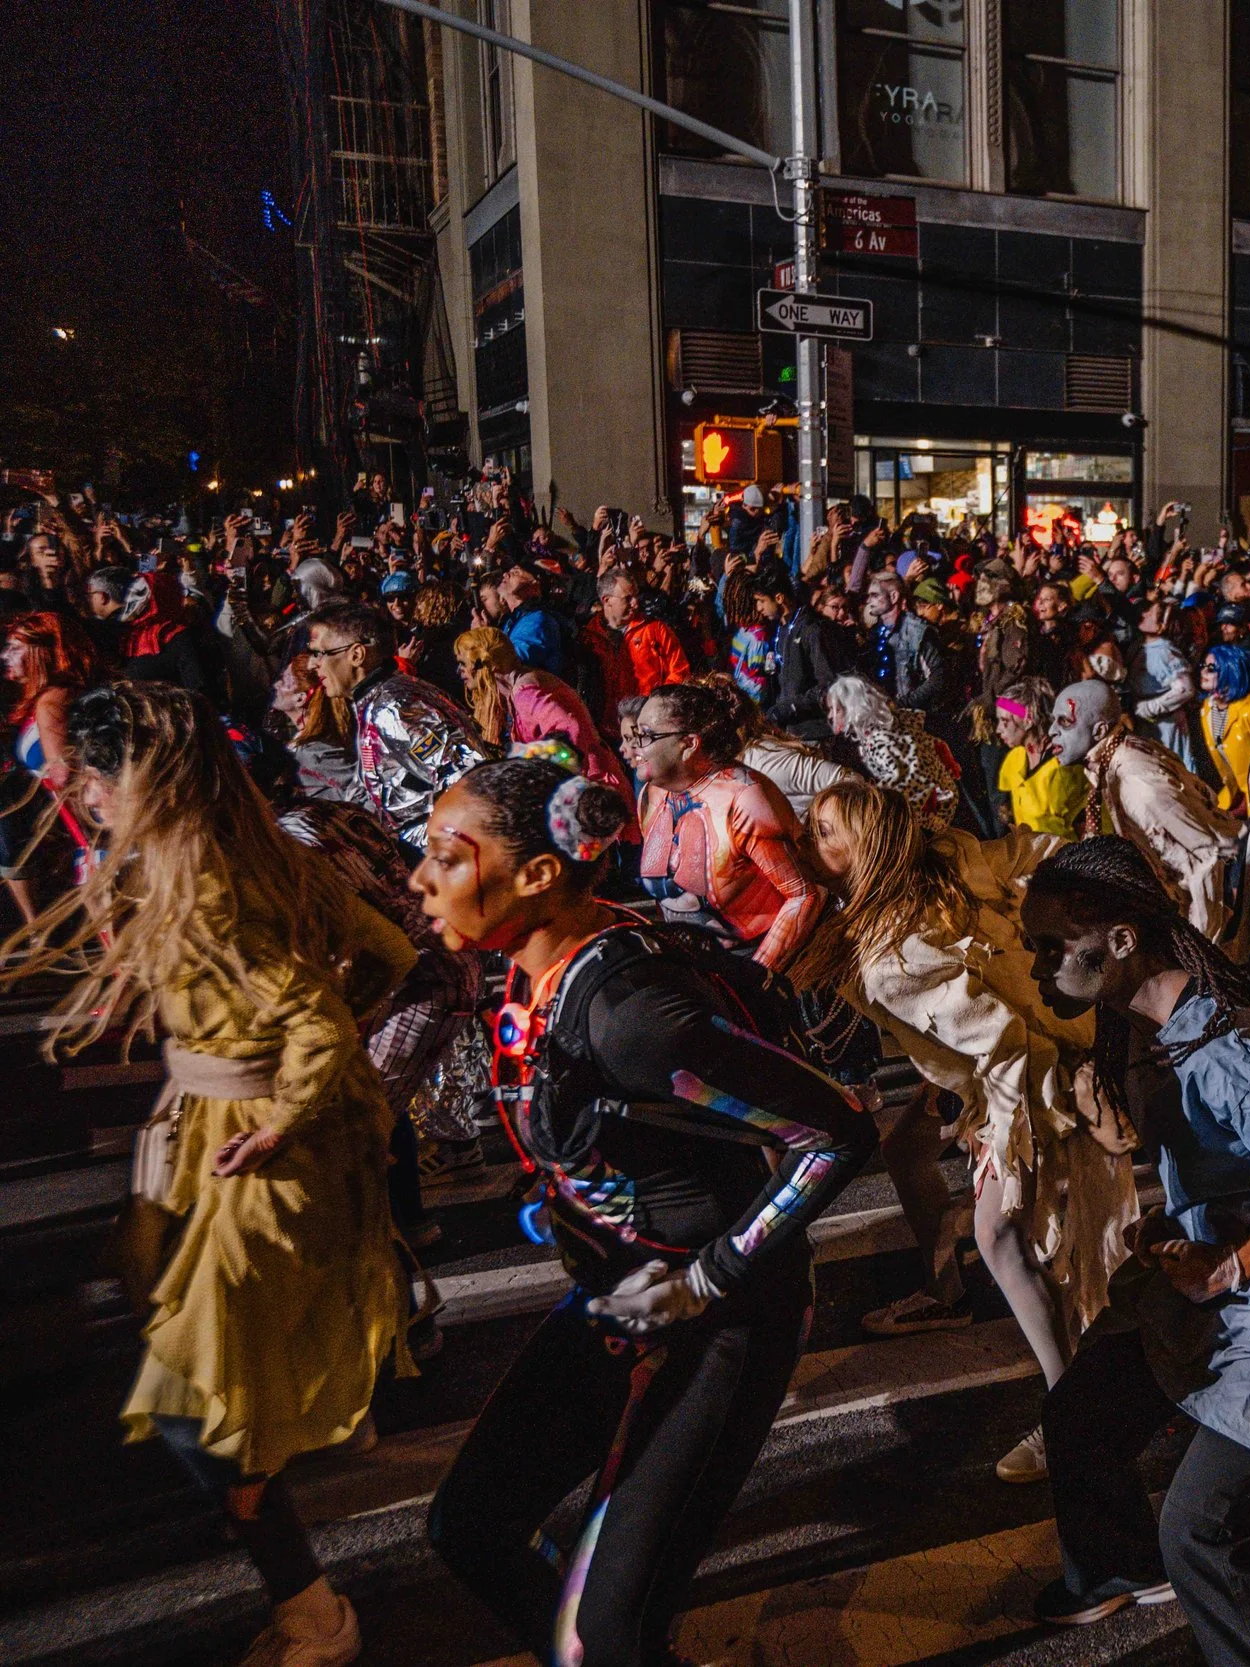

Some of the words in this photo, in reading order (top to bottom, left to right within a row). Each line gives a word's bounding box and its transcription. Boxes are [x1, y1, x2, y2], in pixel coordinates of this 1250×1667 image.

[854, 230, 864, 250] 6
[869, 231, 887, 251] Av
[779, 304, 809, 322] ONE
[829, 309, 860, 327] WAY
